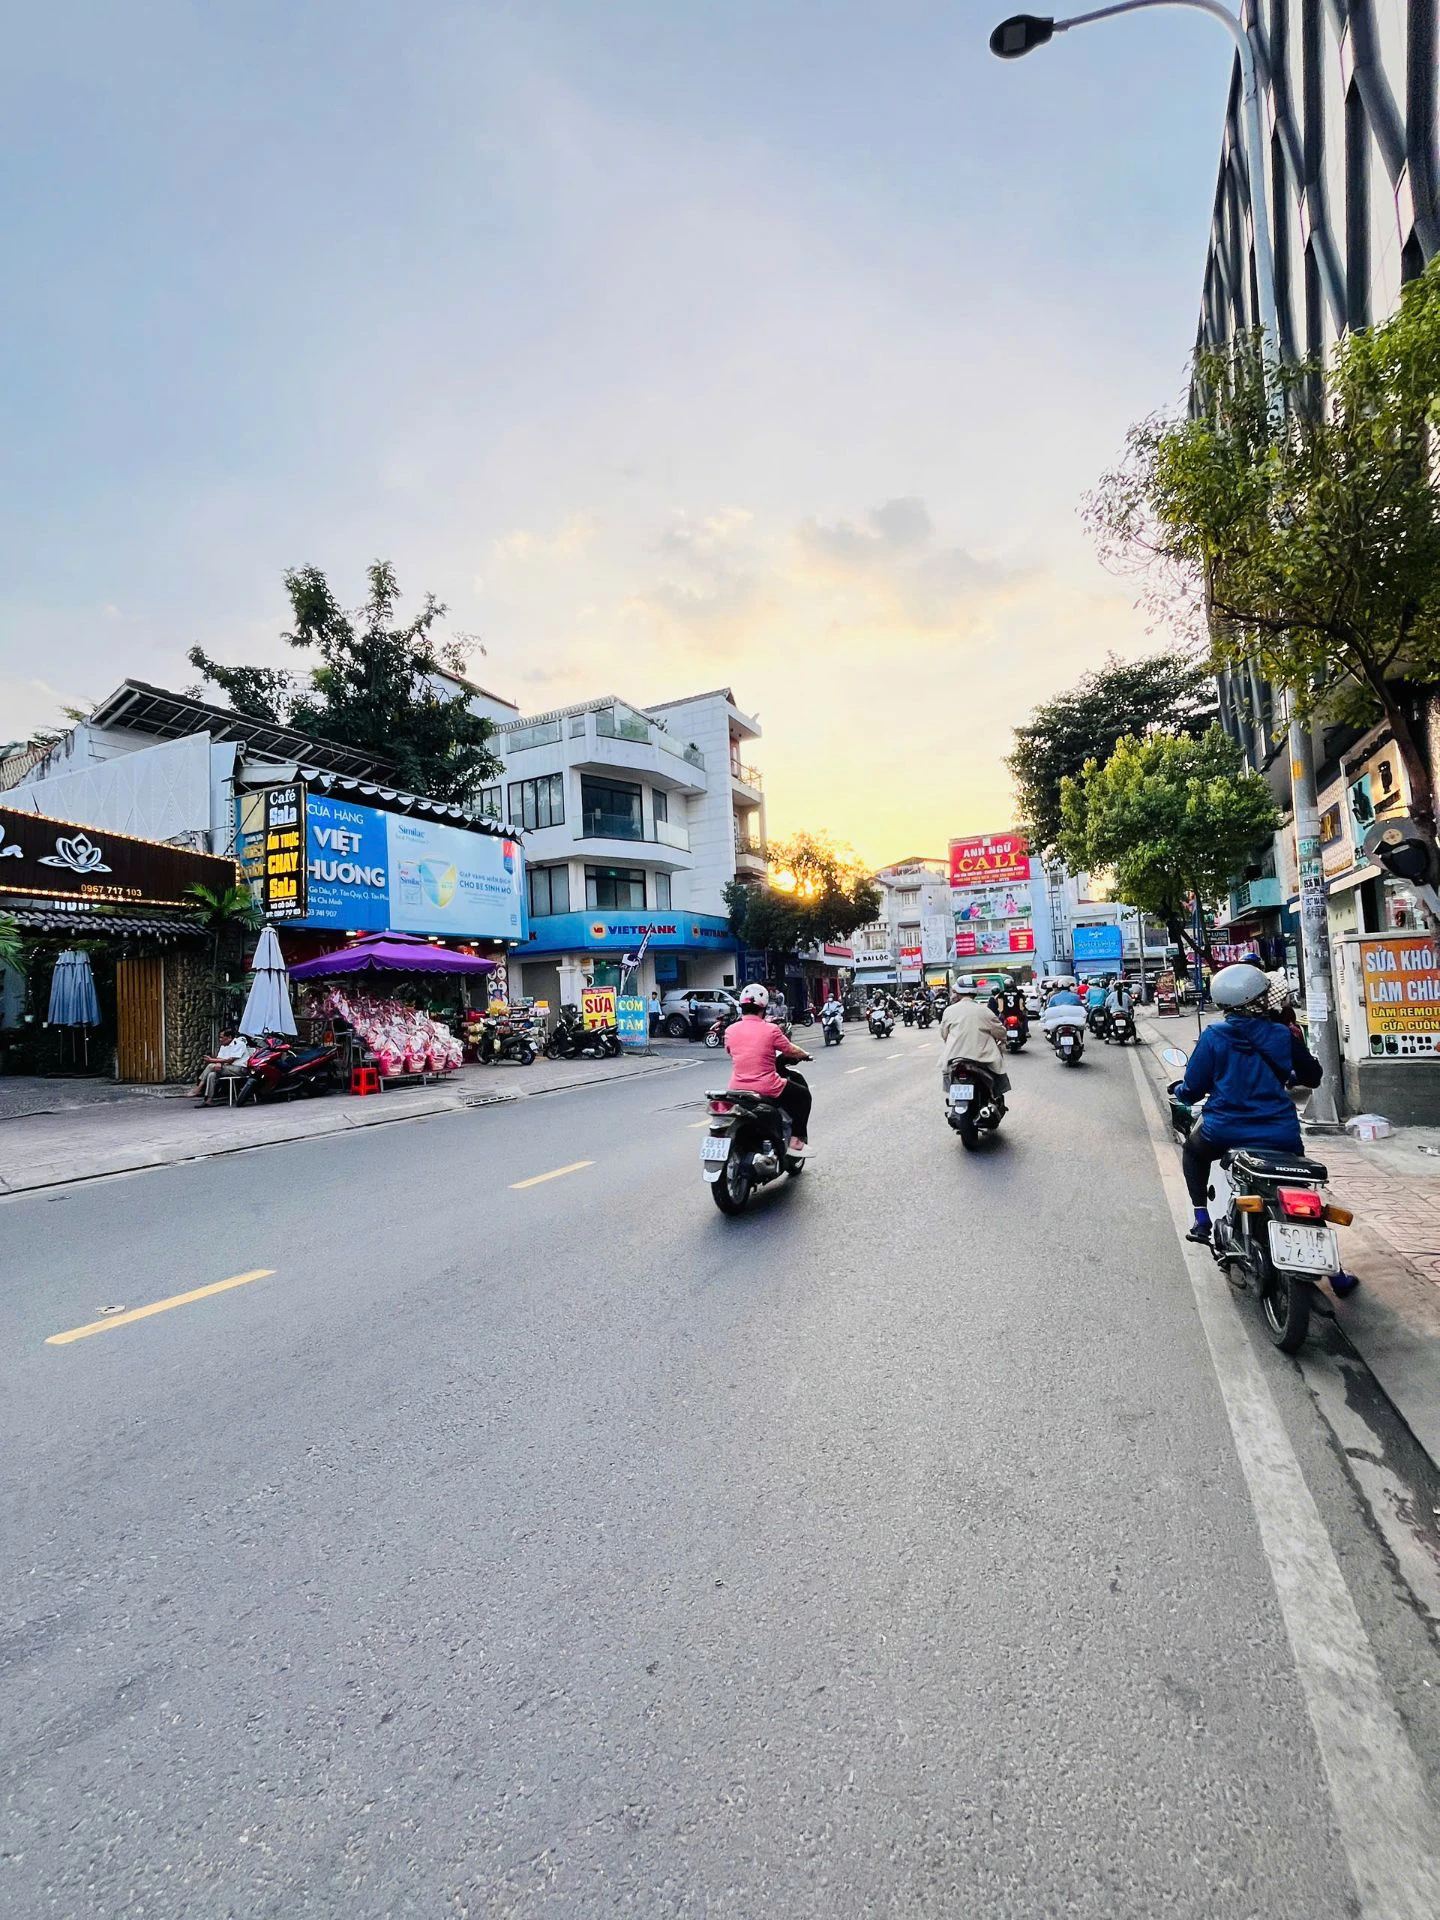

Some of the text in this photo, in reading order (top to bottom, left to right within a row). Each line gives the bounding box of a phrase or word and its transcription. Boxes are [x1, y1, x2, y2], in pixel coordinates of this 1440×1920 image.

[269, 788, 297, 805] Café
[306, 801, 364, 824] CỬA HÀNG
[398, 824, 425, 838] Similac
[312, 825, 363, 856] VIỆT
[963, 841, 1012, 858] ANH NGỮ
[306, 857, 386, 887] HƯƠNG
[81, 884, 142, 897] 0967 717 103
[607, 925, 677, 935] VIETBANK
[1365, 944, 1397, 972] SỬA
[1369, 977, 1403, 1002] LÀM
[584, 994, 613, 1014] SỮA
[618, 998, 643, 1012] CƠM
[1007, 995, 1015, 1008] 3
[1372, 1006, 1440, 1017] LÀM REMOT
[618, 1013, 644, 1031] TẤM
[1382, 1018, 1405, 1031] CỬA
[1275, 1166, 1311, 1174] HONDA
